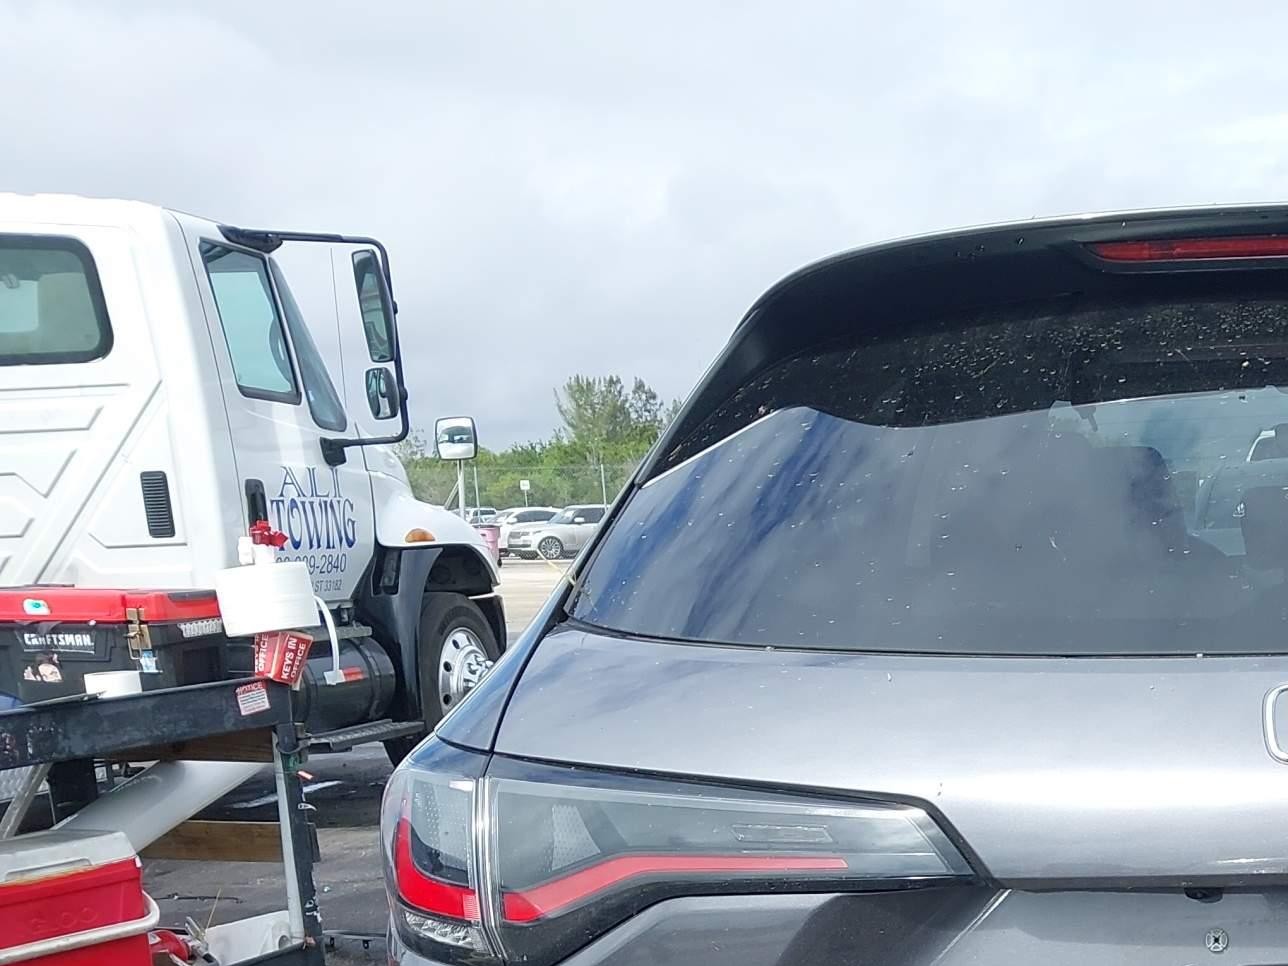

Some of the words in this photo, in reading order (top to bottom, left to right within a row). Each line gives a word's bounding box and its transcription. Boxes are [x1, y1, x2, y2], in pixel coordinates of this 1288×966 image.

[278, 466, 342, 498] ALI
[270, 498, 356, 551] TOWING
[281, 651, 295, 679] KEYS
[288, 637, 298, 650] IN
[290, 642, 307, 678] OFFICE
